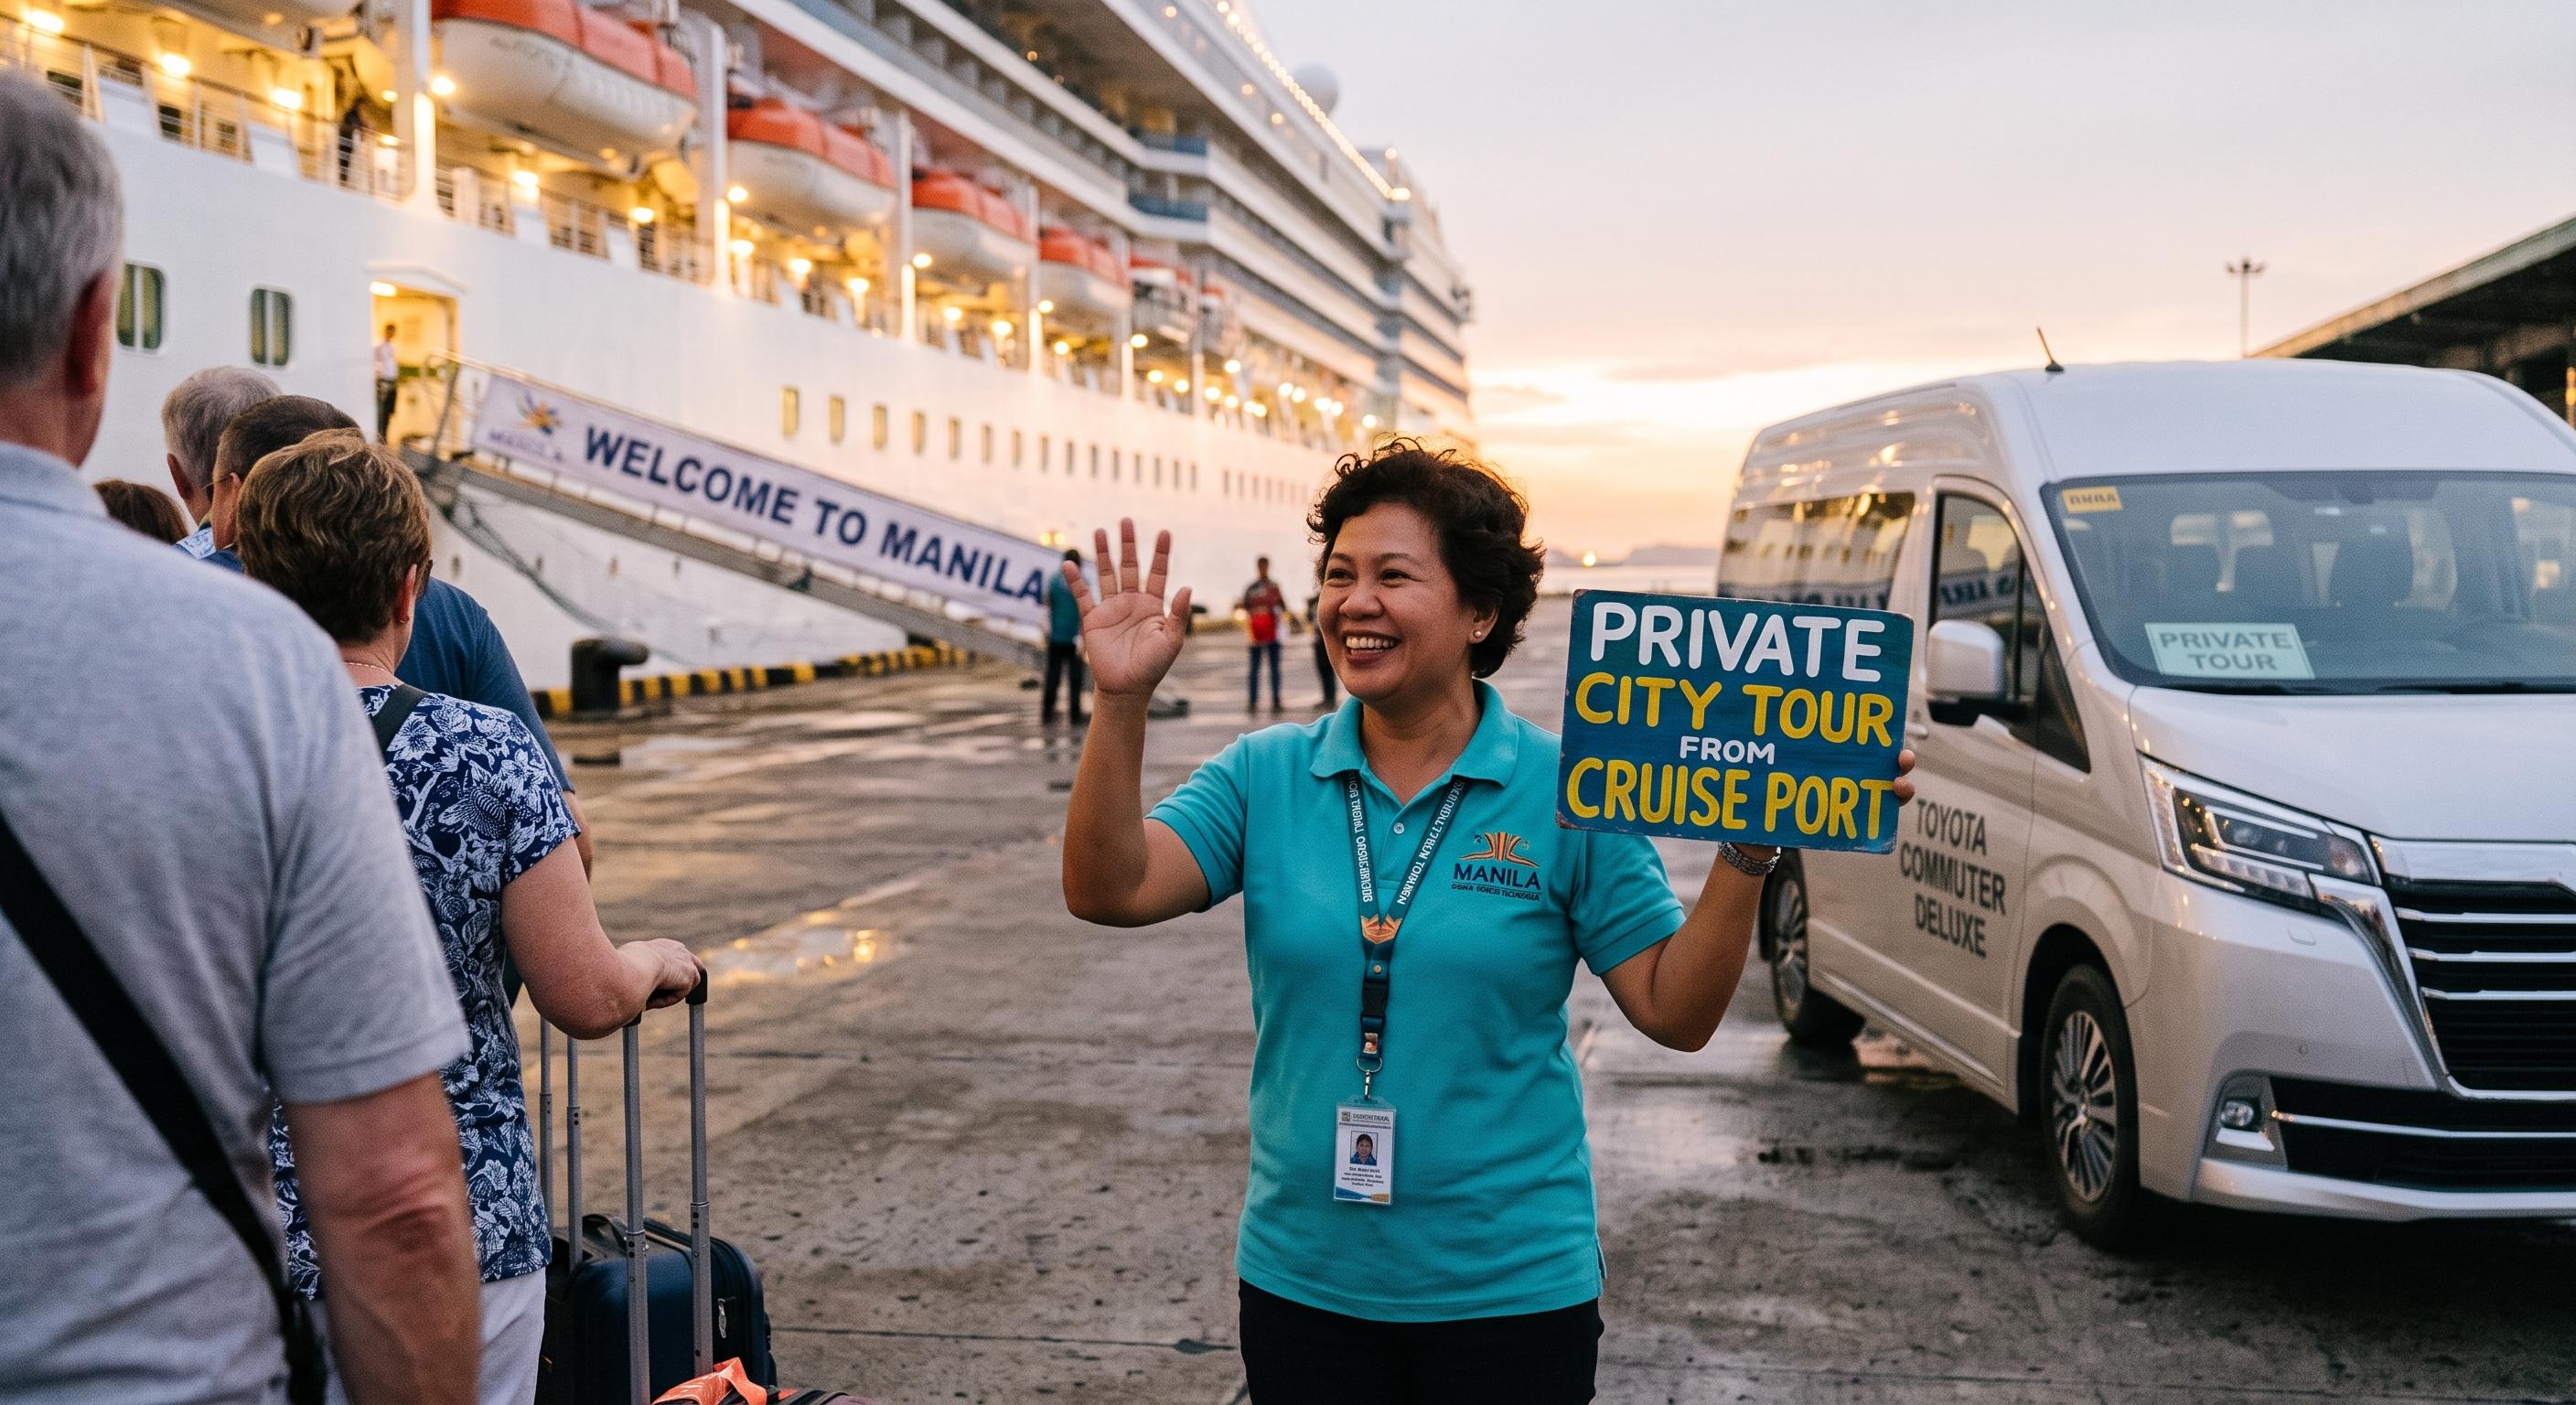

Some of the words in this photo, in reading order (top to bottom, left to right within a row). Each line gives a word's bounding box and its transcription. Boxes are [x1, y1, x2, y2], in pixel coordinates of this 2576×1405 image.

[585, 424, 799, 523] WELCOME
[815, 499, 866, 546] TO
[880, 522, 1044, 606] MANILA
[1590, 602, 1885, 682] PRIVATE
[2160, 632, 2293, 649] PRIVATE
[2188, 653, 2276, 671] TOUR
[1574, 671, 1722, 730] CITY
[1742, 684, 1894, 747] TOUR
[1680, 735, 1776, 765] FROM
[1566, 756, 1751, 830] CRUISE
[1764, 772, 1895, 840] PORT
[1917, 798, 1987, 856] TOYOTA
[1453, 863, 1541, 891] MANILA
[1900, 841, 2006, 916] COMMUTER
[1915, 893, 1987, 959] DELUXE
